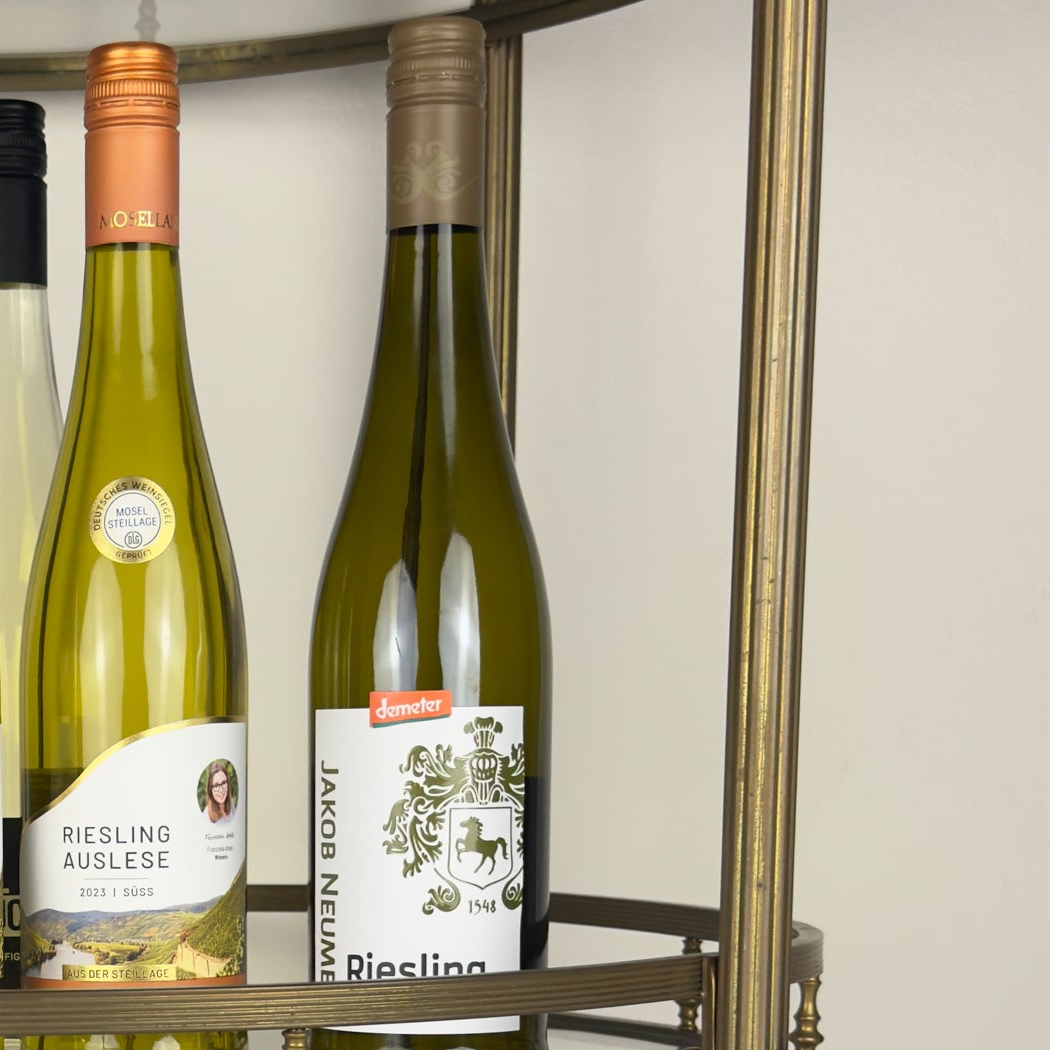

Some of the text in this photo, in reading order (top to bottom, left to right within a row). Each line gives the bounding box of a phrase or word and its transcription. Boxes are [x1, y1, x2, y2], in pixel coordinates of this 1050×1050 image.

[99, 209, 175, 229] MOSELLA
[93, 481, 171, 530] DEUTSCHES WEINSIEGEL
[116, 506, 147, 517] MOSEL
[108, 517, 157, 529] STEILLAGE
[375, 697, 442, 720] demeter
[63, 825, 170, 844] RIESLING
[63, 851, 170, 869] AUSLESE
[320, 760, 339, 982] JAKOB NEUME
[80, 887, 106, 897] 2023
[123, 885, 154, 897] SÜSS
[468, 899, 496, 915] 1548
[67, 969, 169, 979] AUS DER STEILLAGE
